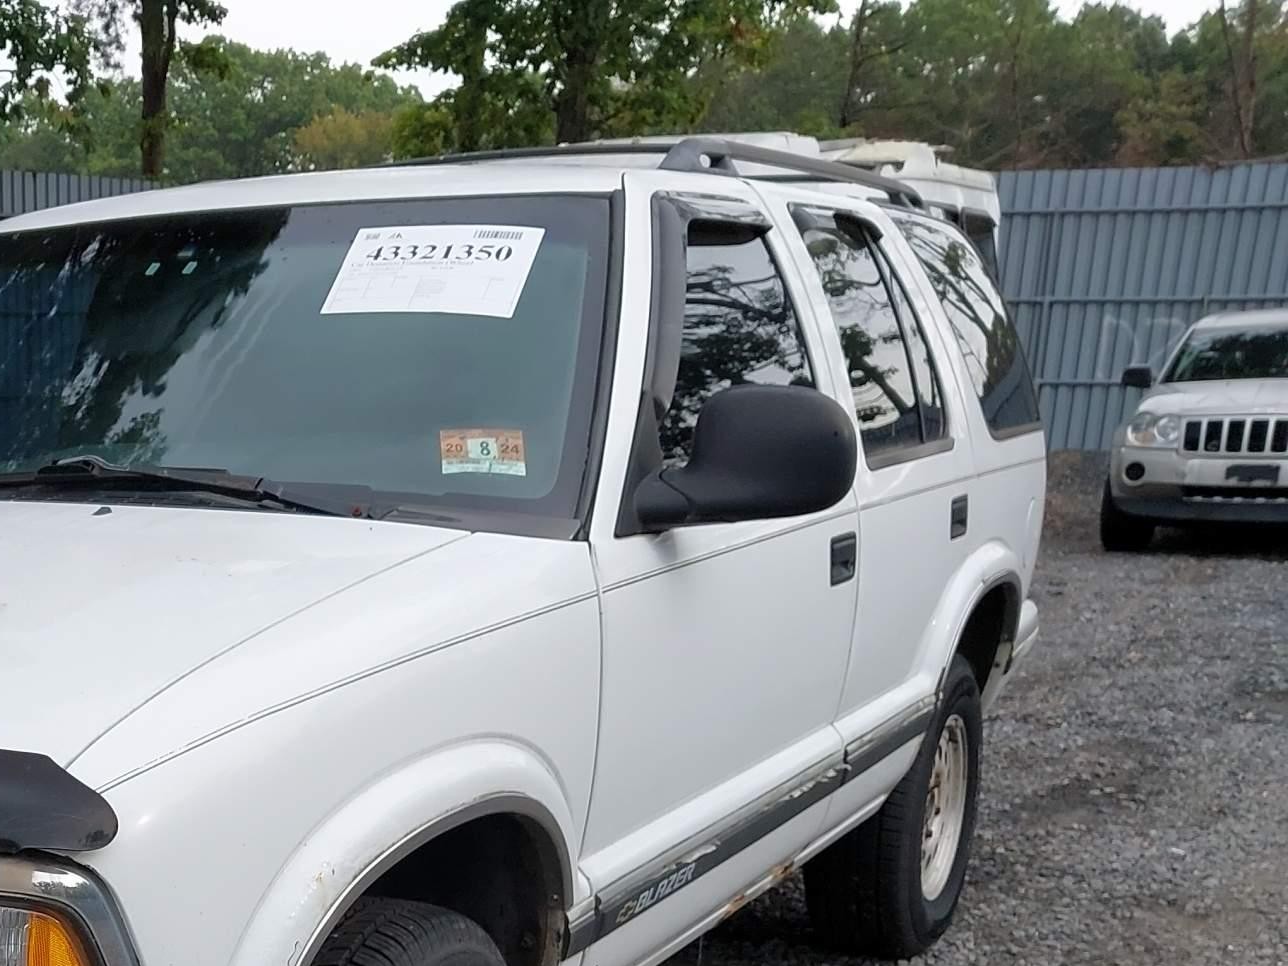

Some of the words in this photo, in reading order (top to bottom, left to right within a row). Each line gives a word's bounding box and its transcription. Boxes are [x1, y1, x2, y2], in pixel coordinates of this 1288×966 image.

[366, 243, 514, 262] 43321350
[445, 443, 464, 454] 20
[479, 440, 491, 456] 8
[500, 443, 520, 455] 24
[634, 862, 696, 913] BLAZER
